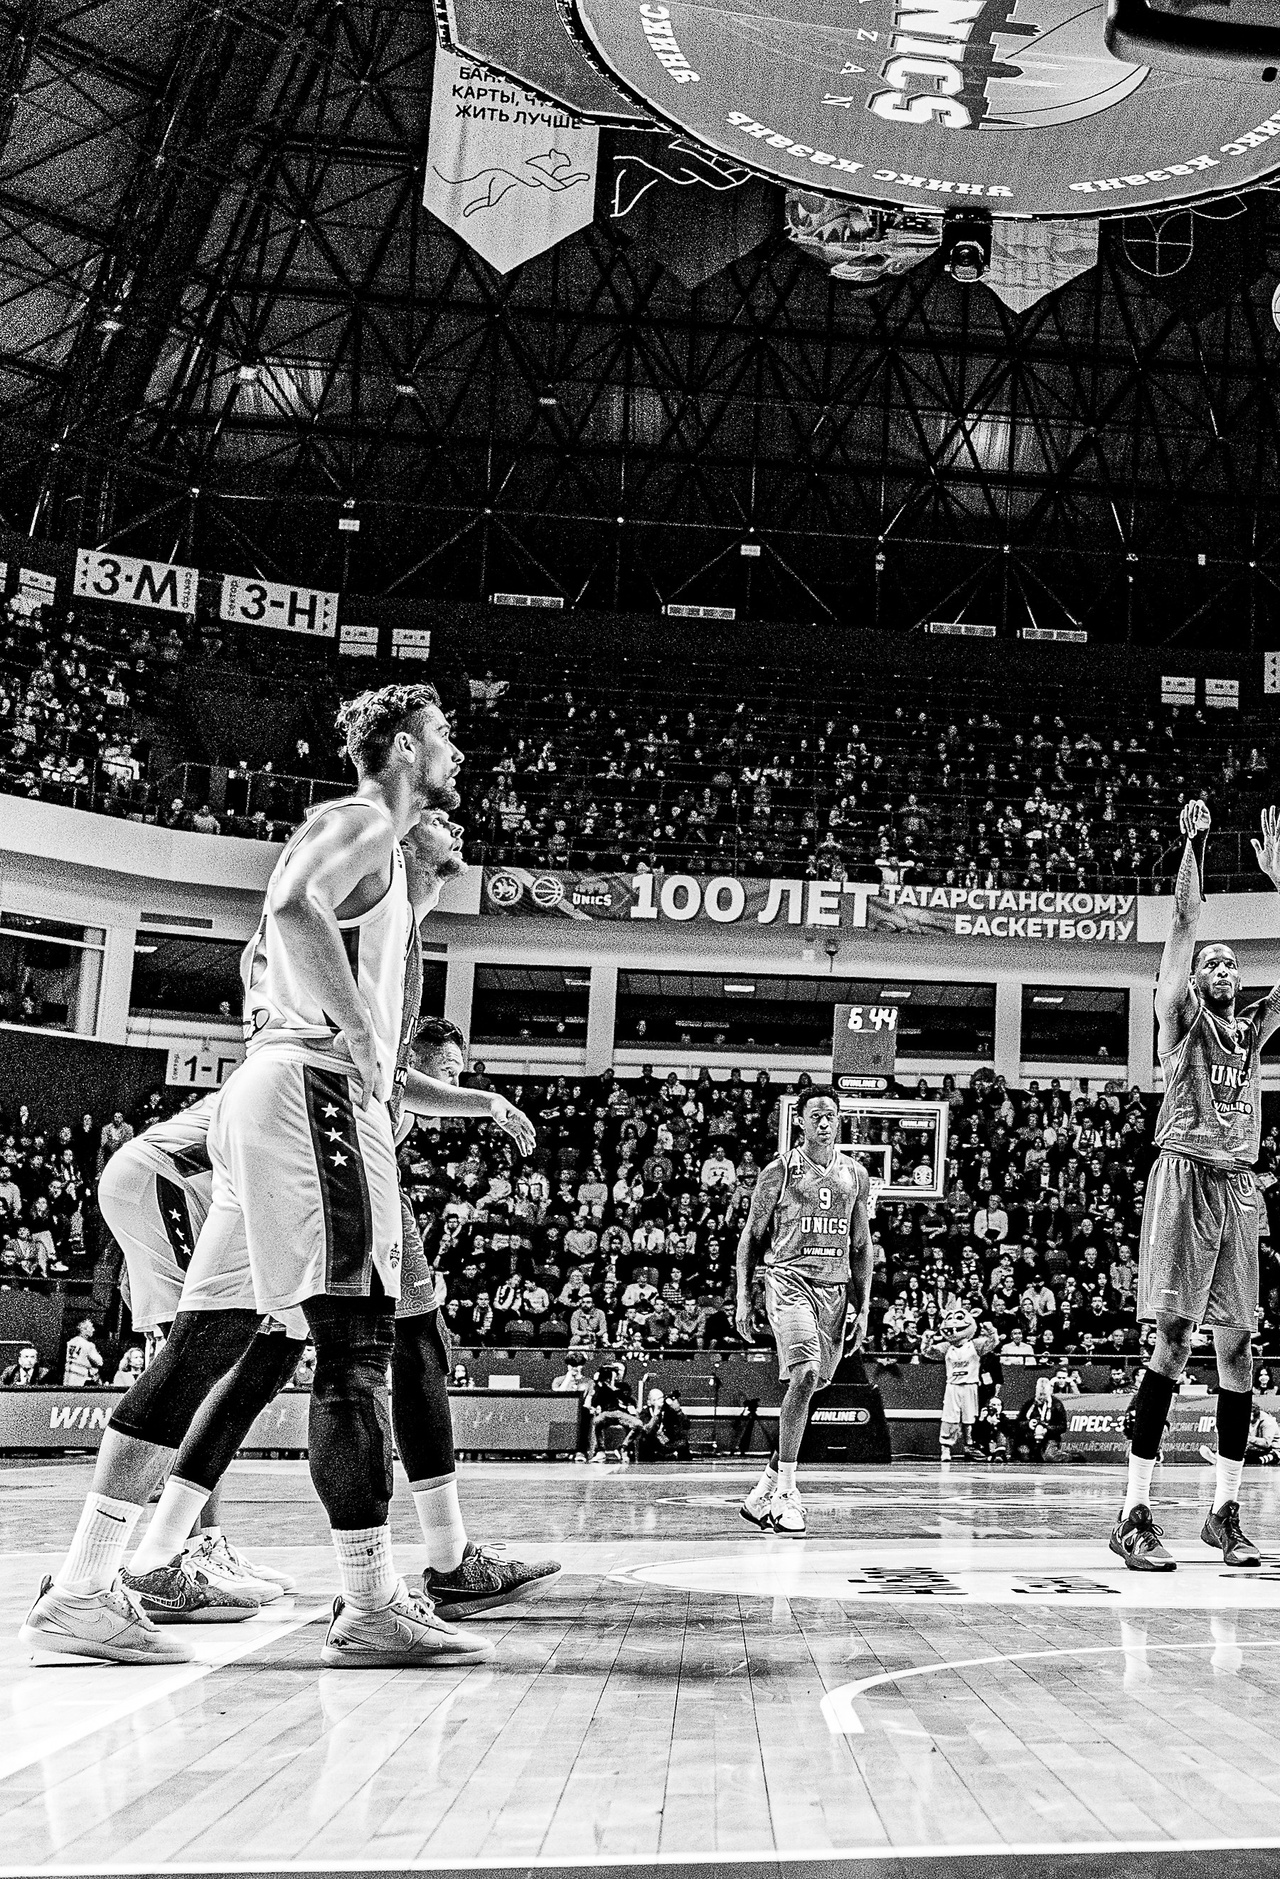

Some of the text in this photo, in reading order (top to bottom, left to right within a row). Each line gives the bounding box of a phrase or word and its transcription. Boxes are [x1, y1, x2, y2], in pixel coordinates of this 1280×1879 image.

[452, 85, 520, 106] КАРТЫ,
[455, 105, 583, 130] ЖИТЬ ЛУЧШЕ
[572, 892, 612, 907] UNICS
[630, 873, 880, 927] 100 ЛЕТ
[884, 884, 1136, 915] ТАТАРСТАНСКОМУ
[954, 914, 1134, 941] БАСКЕТБОЛУ
[819, 1187, 832, 1210] 9
[801, 1216, 848, 1235] UNICS
[803, 1247, 837, 1256] WINLINE
[49, 1406, 112, 1430] WIN
[811, 1411, 857, 1422] WINLINE
[1069, 1415, 1125, 1432] ПРЕСС-З
